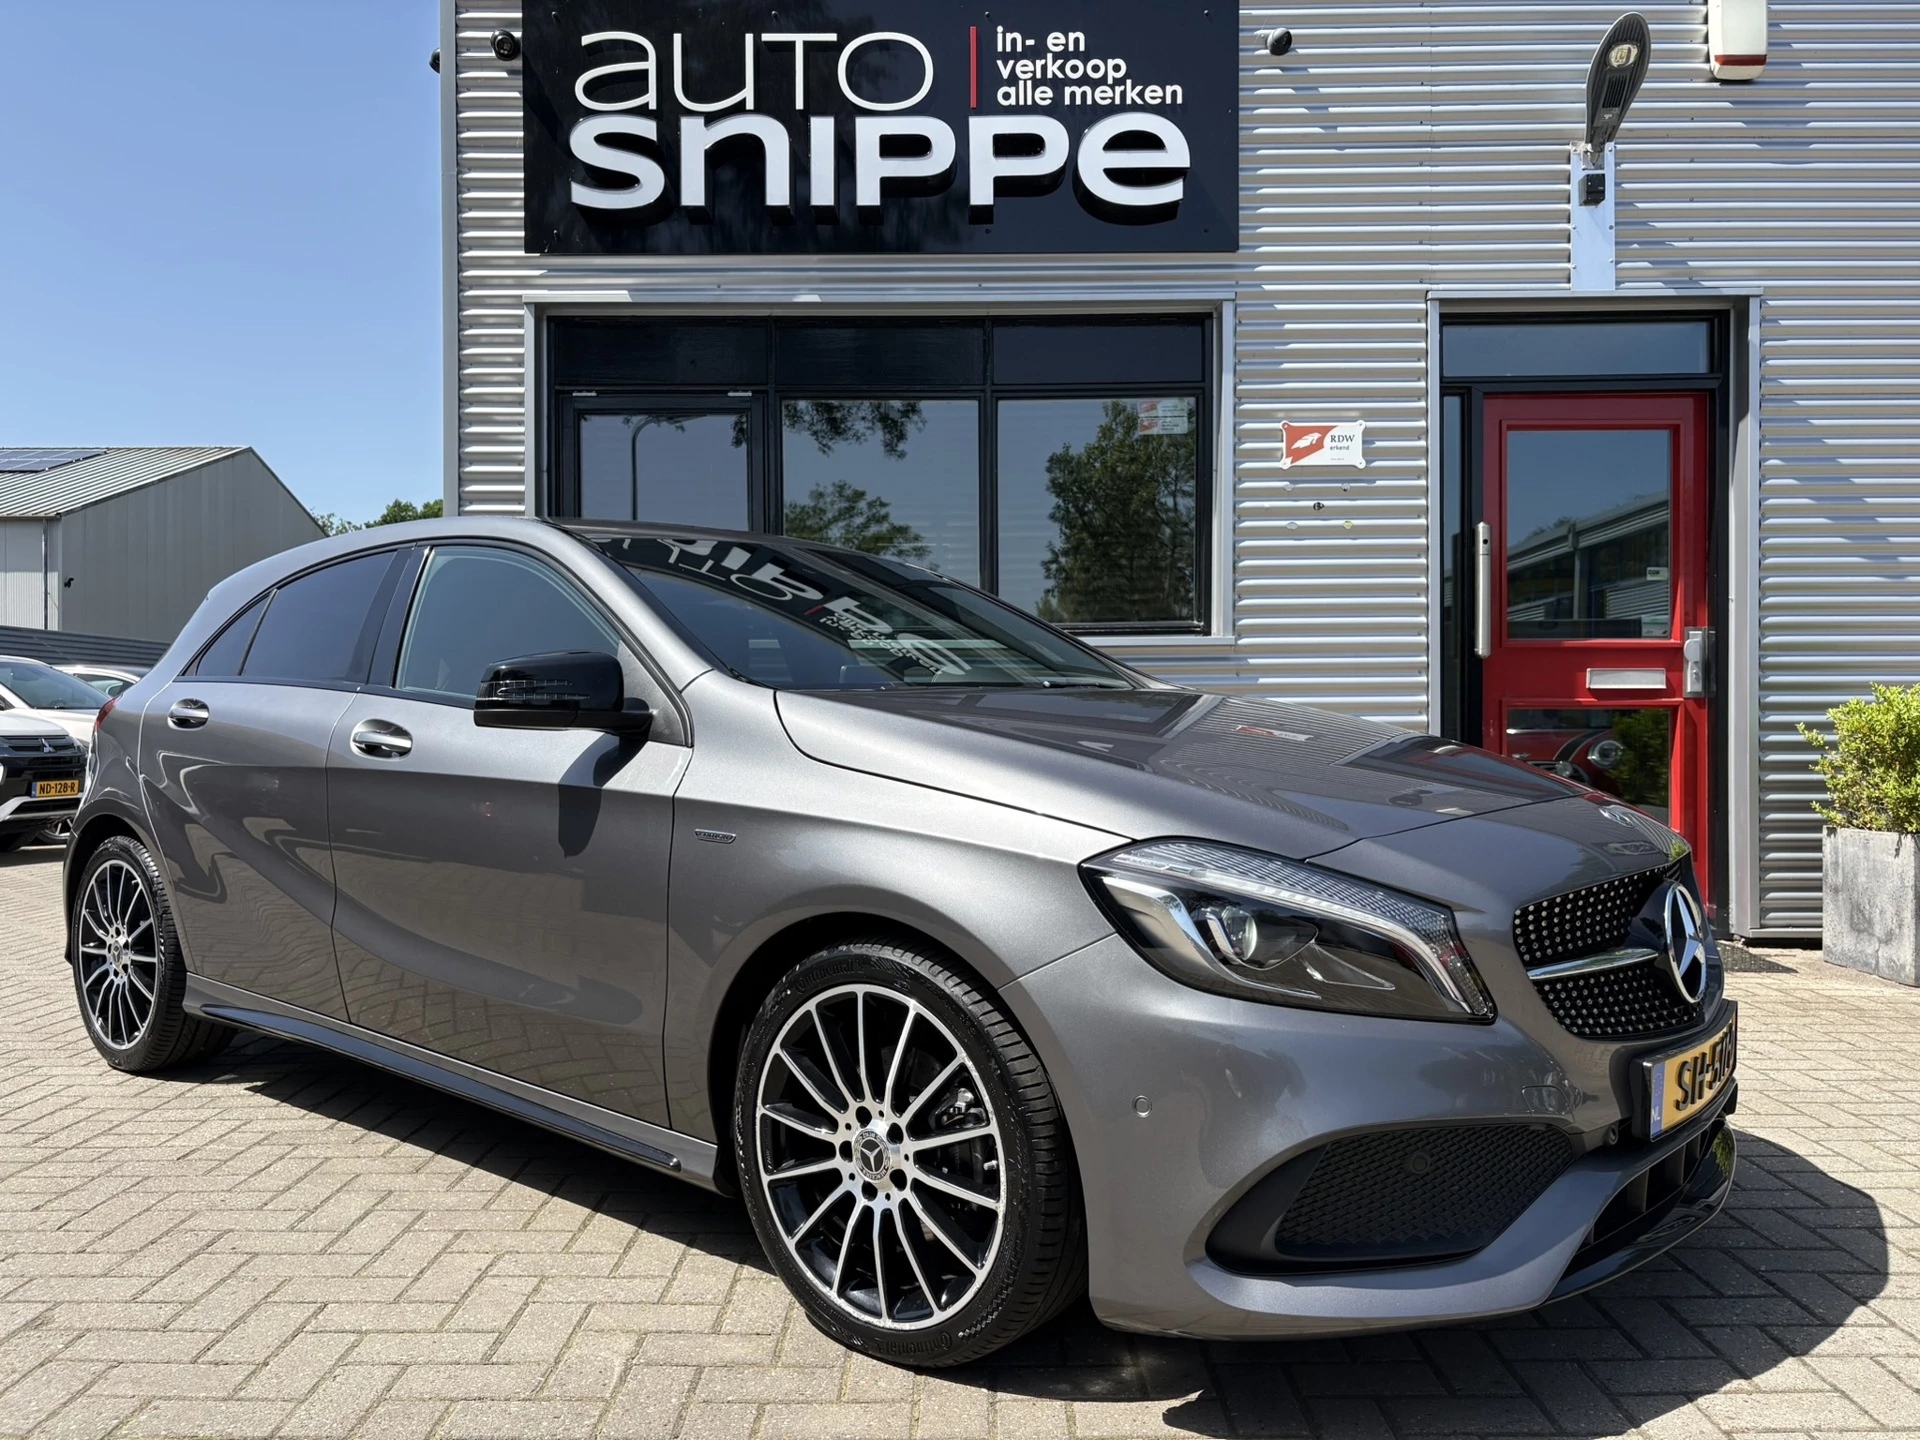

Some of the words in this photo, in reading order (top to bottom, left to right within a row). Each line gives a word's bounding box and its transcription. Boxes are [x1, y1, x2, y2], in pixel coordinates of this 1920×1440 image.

[996, 25, 1035, 53] in-
[1046, 31, 1086, 53] en
[996, 53, 1127, 85] verkoop
[996, 80, 1054, 106] alle
[1064, 79, 1183, 106] merken
[1329, 434, 1355, 443] RDW
[39, 782, 76, 795] ND-128-R
